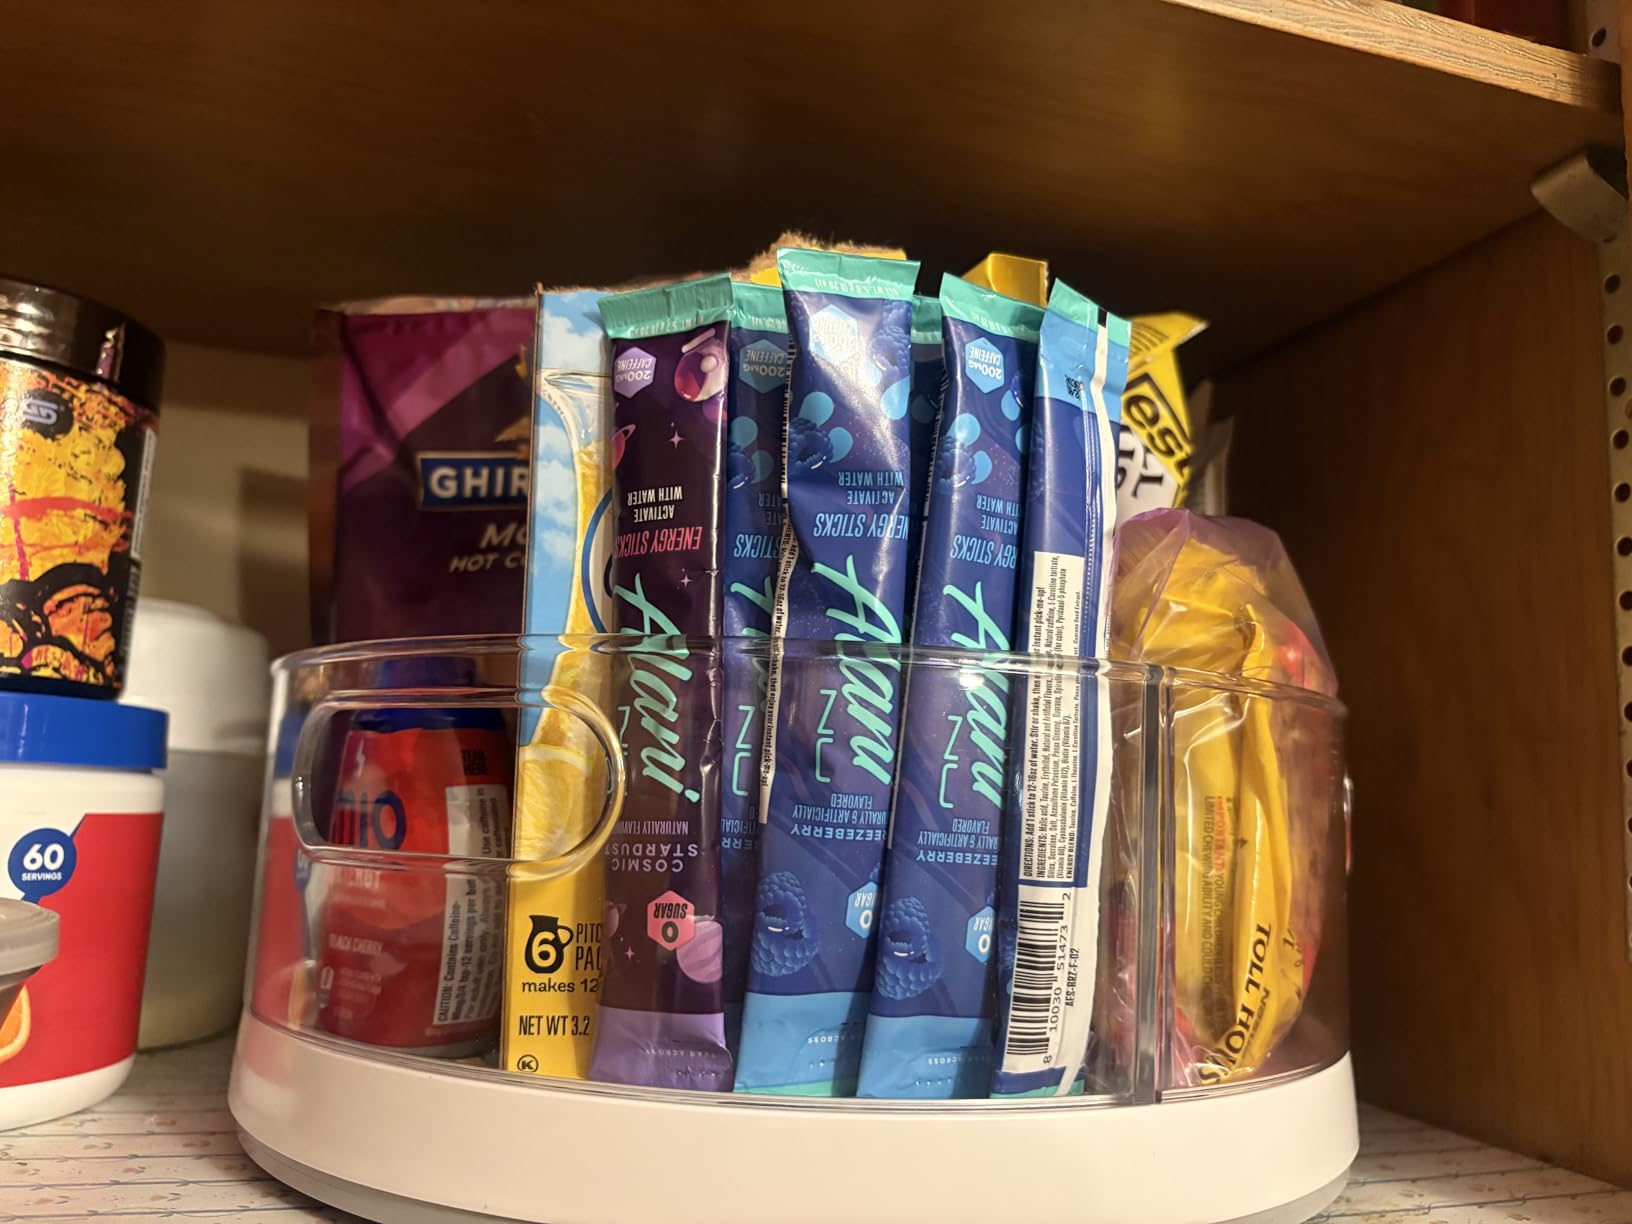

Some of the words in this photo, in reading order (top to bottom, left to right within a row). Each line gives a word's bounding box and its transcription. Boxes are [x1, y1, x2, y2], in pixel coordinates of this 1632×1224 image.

[618, 358, 653, 371] CAFFEINE
[745, 348, 784, 364] CAFFEINE
[970, 346, 1001, 366] CAFFEINE
[616, 370, 650, 382] 200MG
[743, 362, 785, 377] 200MG
[969, 360, 1003, 379] 200MG
[838, 471, 874, 487] WATER
[877, 471, 904, 487] WITH
[627, 489, 656, 506] WATER
[659, 486, 683, 502] WITH
[847, 490, 895, 506] ACTIVATE
[976, 494, 1005, 511] WATER
[633, 504, 675, 522] ACTIVATE
[813, 512, 865, 538] STICKS
[980, 514, 1019, 536] ACTIVATE
[616, 530, 650, 558] STICKS
[650, 526, 703, 553] ENERGY
[950, 534, 995, 565] STICKS
[449, 553, 500, 573] HOT
[1049, 555, 1059, 577] tartrate,
[1057, 568, 1067, 593] phosphate
[1047, 577, 1057, 605] L-Carnitine
[1033, 586, 1045, 624] pick-me-up!
[1045, 606, 1055, 628] caffeine,
[1032, 624, 1041, 646] instant
[1044, 628, 1053, 647] Natural
[613, 572, 700, 803] Alani
[1031, 679, 1040, 694] then
[1044, 678, 1053, 698] Flavors,
[1030, 695, 1041, 715] shake,
[815, 689, 838, 783] NU
[1029, 724, 1038, 737] Stir
[1041, 722, 1050, 731] and
[732, 704, 756, 796] NU
[1028, 738, 1038, 758] water.
[1040, 732, 1051, 751] Natural
[1051, 742, 1060, 757] Panax
[939, 715, 964, 808] NU
[1040, 753, 1051, 779] Erythritol,
[1027, 768, 1037, 791] 12-16oz
[1049, 758, 1060, 786] Potassium,
[830, 793, 873, 808] FLAVORED
[1039, 780, 1050, 801] Taurine,
[1025, 800, 1035, 817] stick
[1039, 803, 1048, 816] acid,
[1048, 787, 1059, 817] Acesulfame
[791, 803, 849, 823] ARTIFICIALLY
[641, 820, 690, 835] NATURALLY
[952, 818, 990, 834] FLAVORED
[1025, 822, 1034, 835] Add
[1038, 816, 1047, 831] Malic
[917, 830, 967, 848] ARTIFICIALLY
[23, 843, 64, 871] 60
[604, 843, 699, 857] STARDUST
[1022, 836, 1034, 876] DIRECTIONS:
[1035, 832, 1048, 878] INGREDIENTS:
[611, 858, 684, 872] COSMIC
[22, 871, 63, 881] SERVINGS
[1062, 892, 1071, 901] 2
[653, 902, 689, 919] SUGAR
[661, 921, 679, 943] 0
[531, 931, 557, 967] 6
[1057, 925, 1069, 971] 51473
[1245, 923, 1271, 994] TOLL
[522, 978, 575, 993] makes
[1065, 948, 1080, 1007] AES-BRZ-F-02
[437, 982, 453, 1022] CAUTION:
[1049, 987, 1062, 1032] 10030
[519, 1015, 543, 1036] NET
[546, 1015, 570, 1036] WT
[571, 1015, 590, 1036] 3.2
[1043, 1054, 1053, 1064] 8
